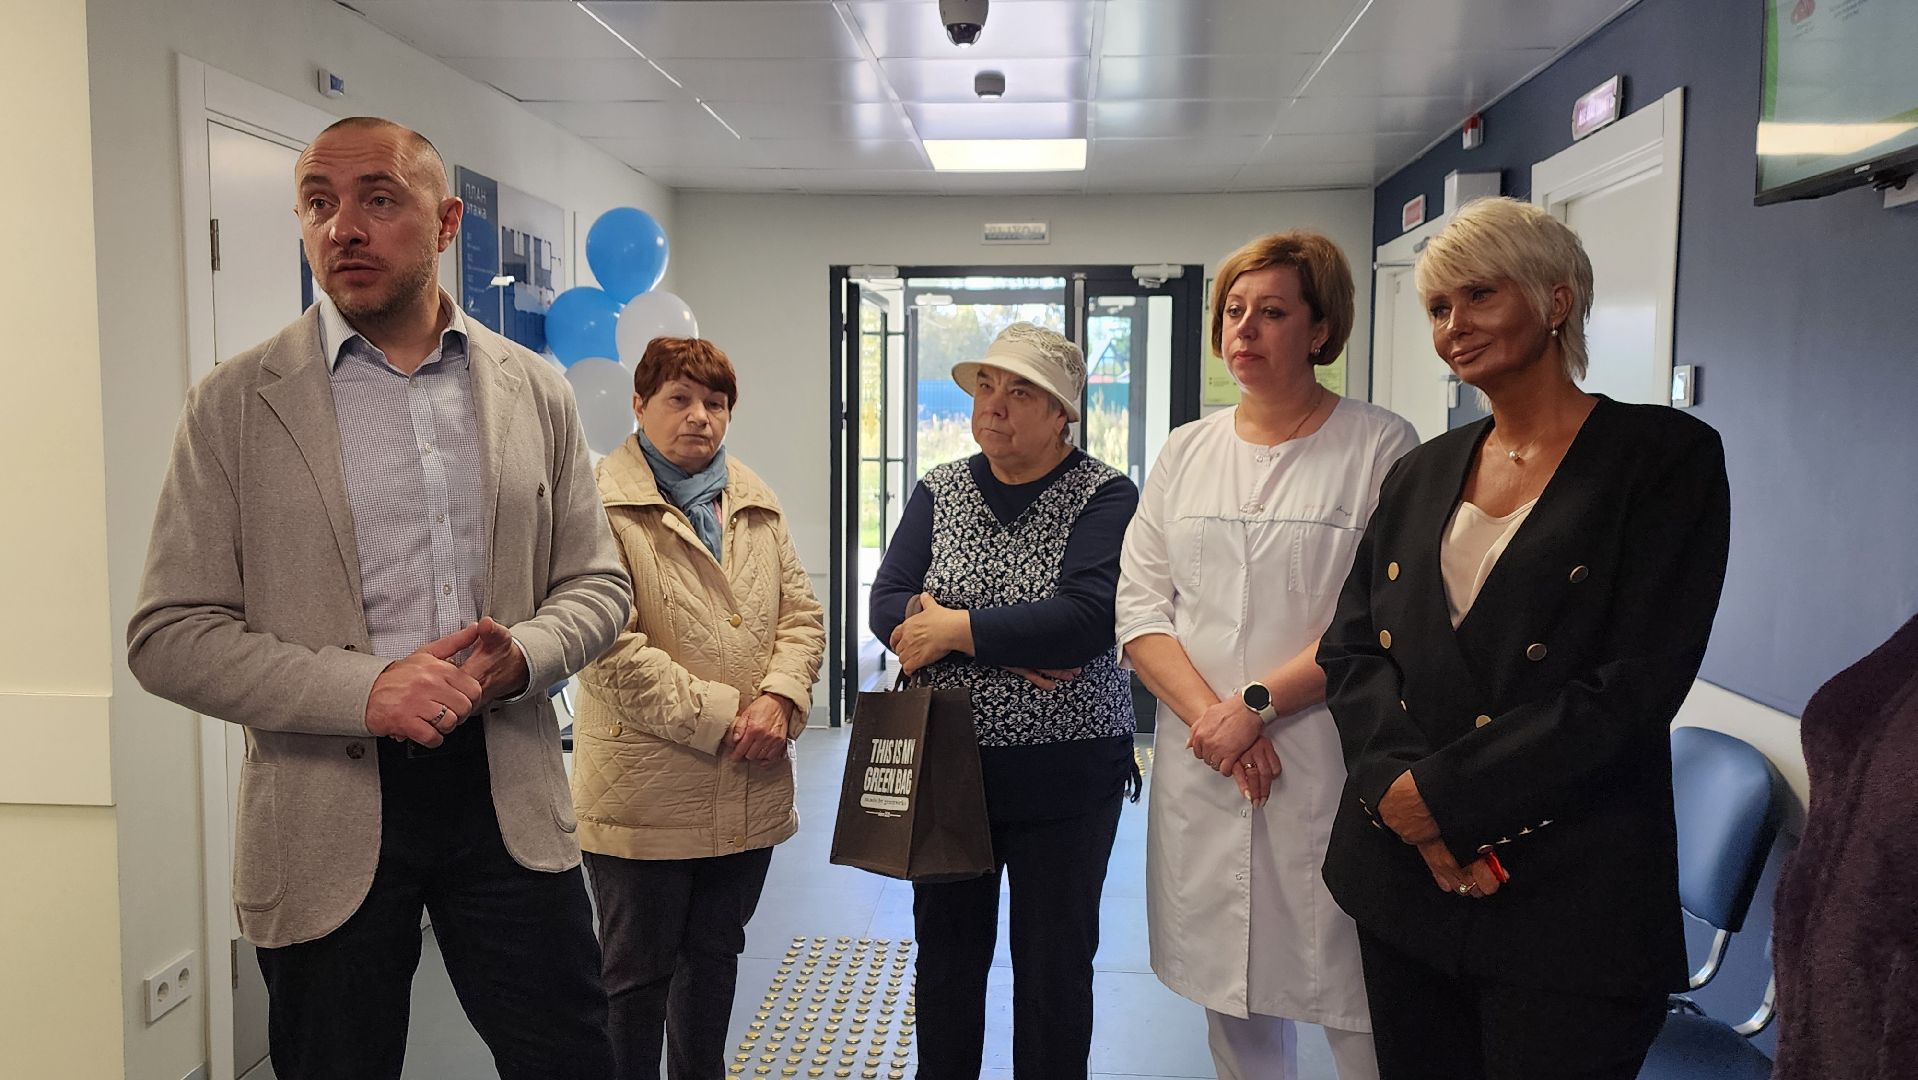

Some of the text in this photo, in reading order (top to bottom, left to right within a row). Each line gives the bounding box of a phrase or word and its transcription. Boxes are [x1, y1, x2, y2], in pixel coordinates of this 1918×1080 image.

[465, 183, 487, 204] ПЛАН
[466, 203, 487, 220] этажа
[870, 739, 916, 765] THIS IS MY
[863, 767, 913, 795] GREEN BAG
